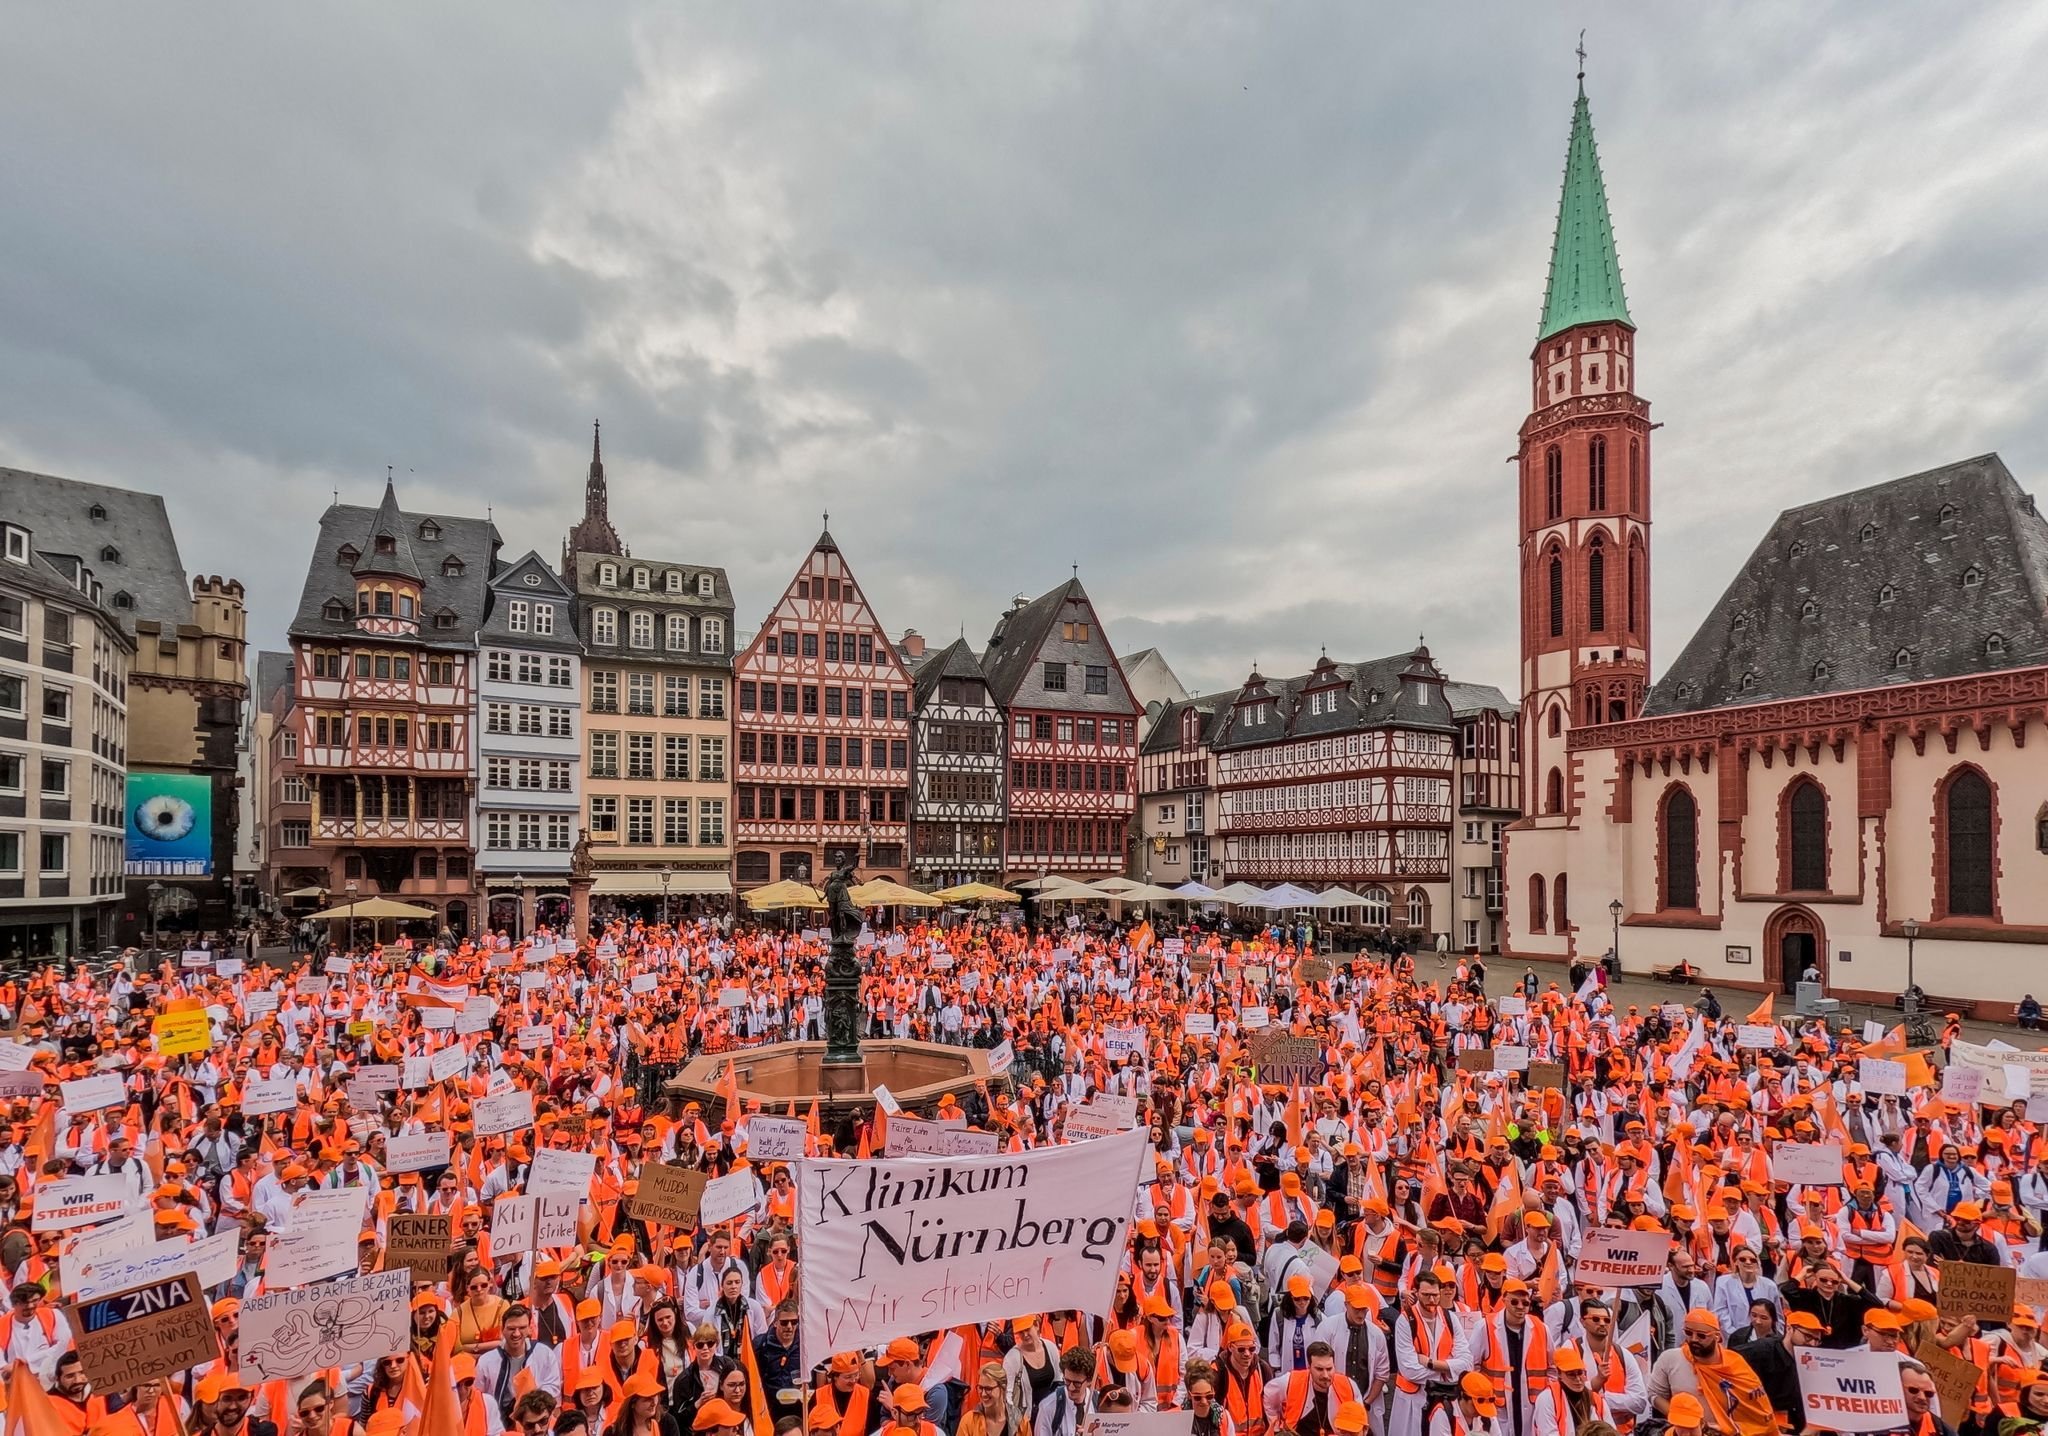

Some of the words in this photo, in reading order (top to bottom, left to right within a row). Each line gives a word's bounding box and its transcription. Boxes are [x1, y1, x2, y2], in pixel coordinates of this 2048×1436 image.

[594, 862, 638, 870] ouvenirs
[671, 861, 725, 871] Geschenke
[1105, 1040, 1134, 1050] LEBEN
[1280, 1035, 1317, 1046] WOHNST
[1270, 1047, 1281, 1055] DU
[1282, 1047, 1316, 1055] JETZT
[1291, 1055, 1313, 1064] DER
[1257, 1061, 1325, 1085] KLINIK?
[891, 1122, 913, 1134] Fairer
[913, 1125, 929, 1136] Lohn
[1067, 1122, 1084, 1131] GUTE
[1085, 1126, 1110, 1136] ARBEIT
[1067, 1130, 1088, 1140] GUTES
[653, 1177, 689, 1196] MUDDA
[814, 1163, 1030, 1227] Klinikum
[62, 1193, 94, 1205] WIR
[36, 1200, 122, 1221] STREIKEN!
[496, 1205, 525, 1226] Kli
[542, 1202, 570, 1217] Lu
[632, 1200, 694, 1224] UNTERVERSORGT
[390, 1219, 449, 1236] KEINER
[493, 1233, 522, 1251] on
[538, 1221, 576, 1241] strike!
[390, 1238, 449, 1250] ERWARTET
[851, 1199, 1125, 1282] Nürnberg
[1607, 1248, 1639, 1262] WIR
[1580, 1260, 1662, 1276] STREIKEN!
[1943, 1262, 1993, 1278] KENNT
[241, 1293, 283, 1314] ARBEIT
[311, 1287, 321, 1301] 8
[362, 1270, 410, 1292] BEZAHLT
[1973, 1279, 2007, 1291] NOCH
[121, 1281, 190, 1319] ZNA
[370, 1285, 410, 1303] WERDEN
[825, 1284, 904, 1349] Wir
[921, 1256, 1053, 1320] streiken!
[1941, 1288, 2007, 1301] CORONA?
[1940, 1300, 1964, 1312] WIR
[1968, 1303, 2010, 1315] SCHON!
[78, 1325, 149, 1351] BEGRENZTES
[83, 1351, 99, 1370] 2
[91, 1371, 128, 1391] zum
[125, 1355, 166, 1381] Preis
[166, 1349, 195, 1367] von
[1836, 1377, 1877, 1395] WIR
[1807, 1394, 1903, 1415] STREIKEN!
